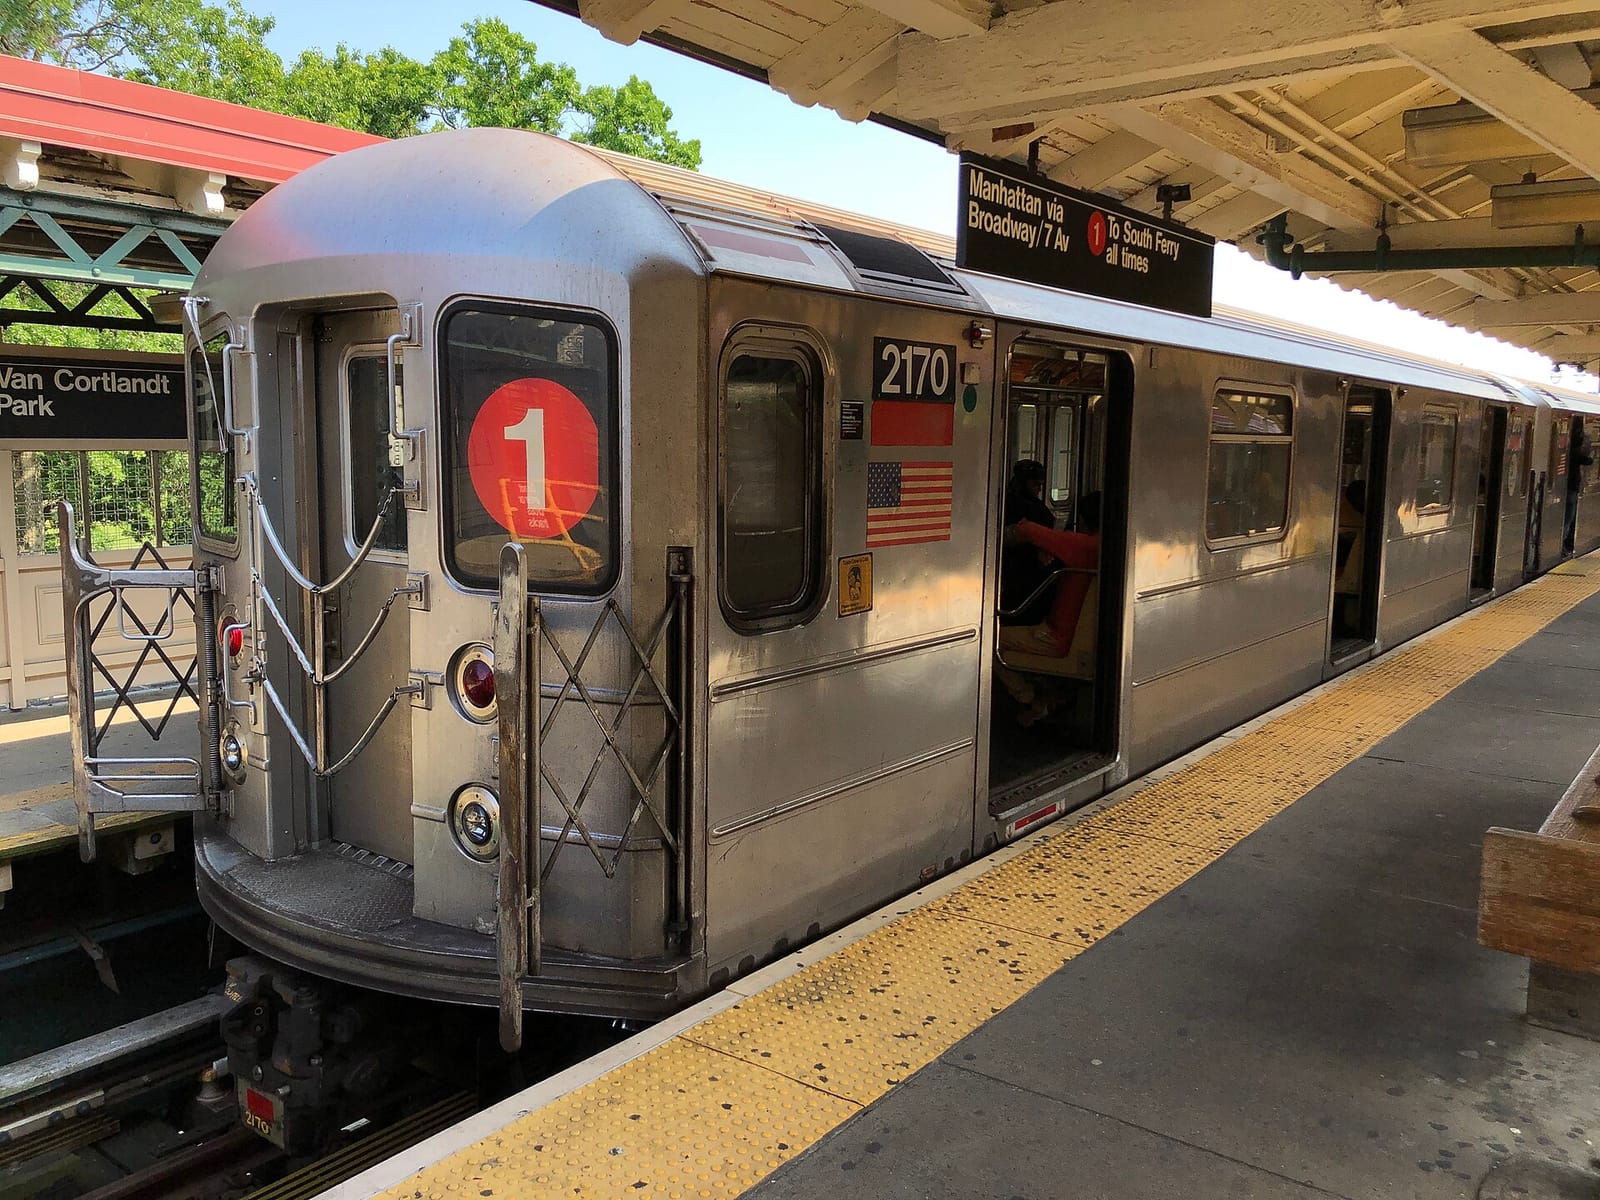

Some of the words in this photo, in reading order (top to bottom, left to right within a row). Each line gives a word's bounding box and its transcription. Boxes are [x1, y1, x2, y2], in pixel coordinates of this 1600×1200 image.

[969, 168, 1042, 217] Manhattan
[1047, 197, 1064, 224] via
[1054, 230, 1070, 253] Av
[1107, 215, 1120, 240] To
[1123, 222, 1152, 251] South
[1155, 231, 1180, 261] Ferry
[1106, 246, 1118, 266] all
[1121, 249, 1149, 274] times
[0, 367, 43, 390] Van
[54, 368, 171, 394] Cortlandt
[881, 343, 949, 396] 2170
[0, 394, 56, 417] Park
[503, 408, 546, 510] 1
[245, 1111, 269, 1134] 2170
